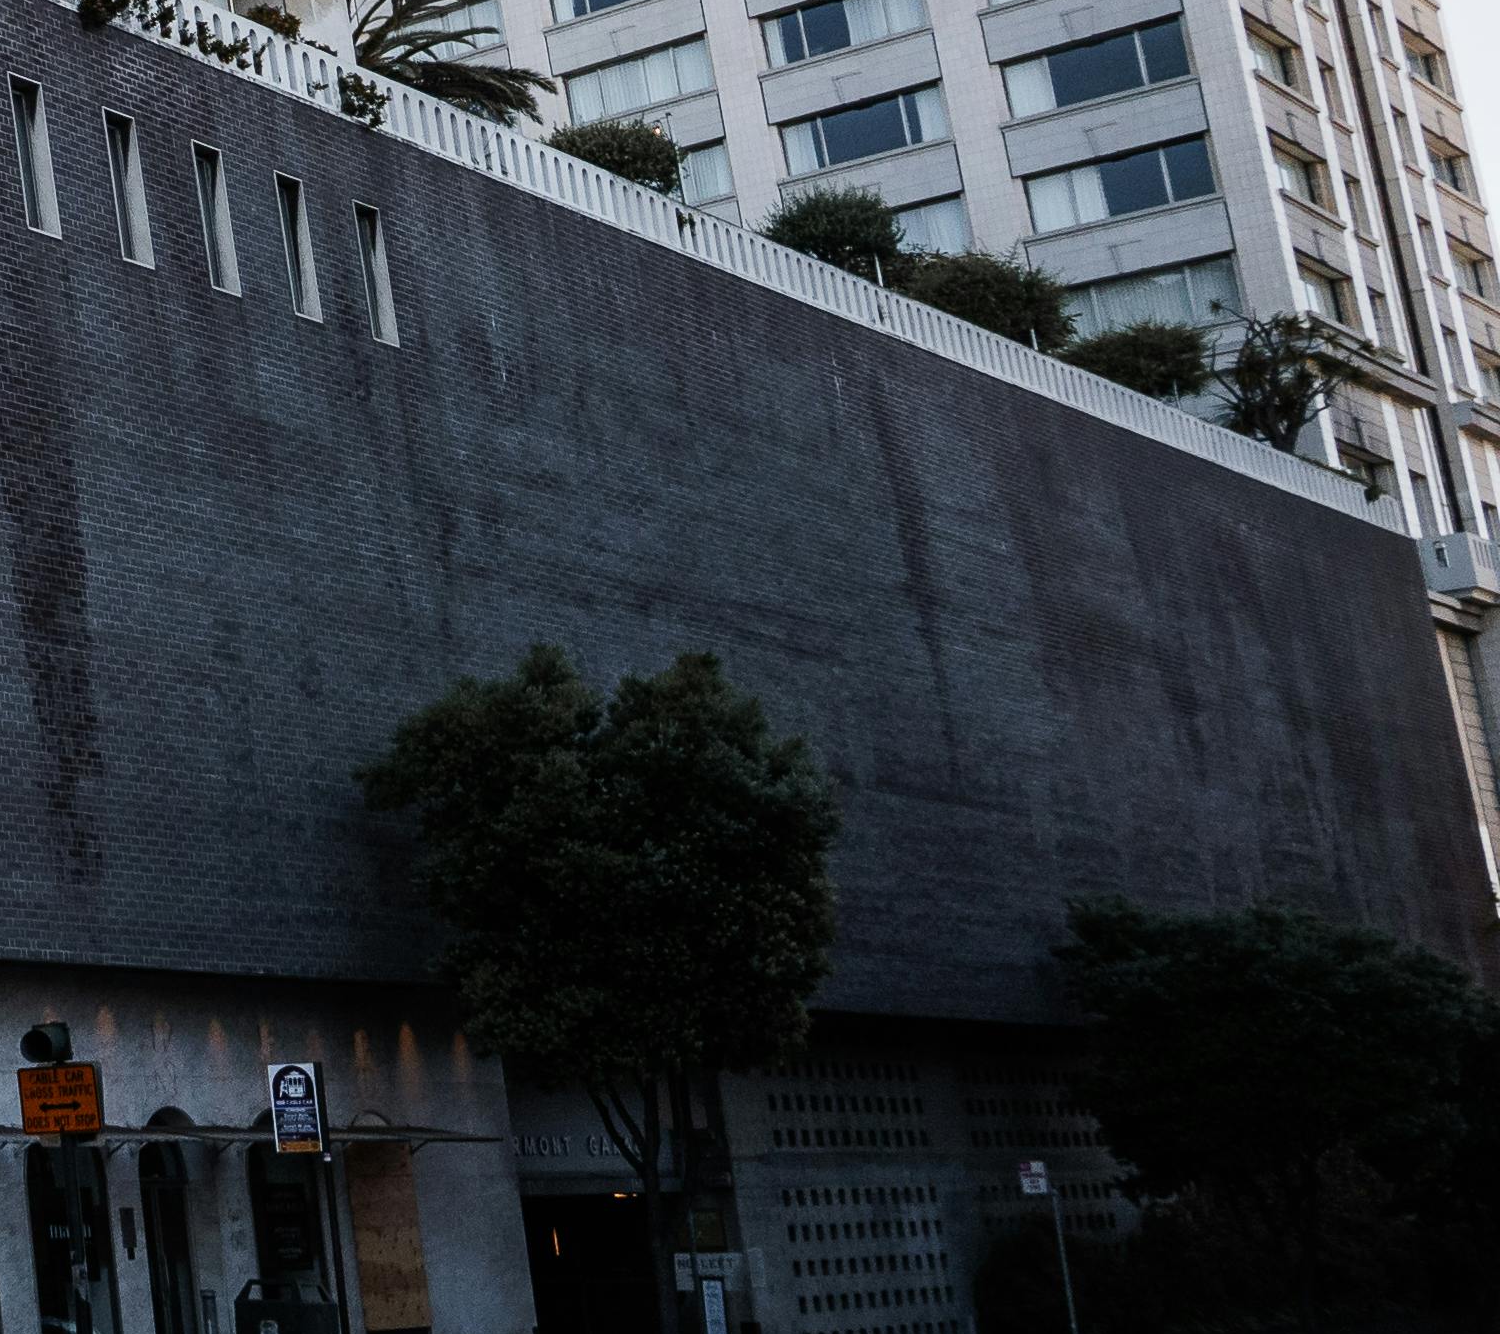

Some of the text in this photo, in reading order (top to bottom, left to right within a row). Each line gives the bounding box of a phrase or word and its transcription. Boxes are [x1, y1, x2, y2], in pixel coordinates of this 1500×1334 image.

[27, 1069, 85, 1084] CABLE CAR
[54, 1115, 70, 1128] NOT
[75, 1114, 97, 1126] STOP
